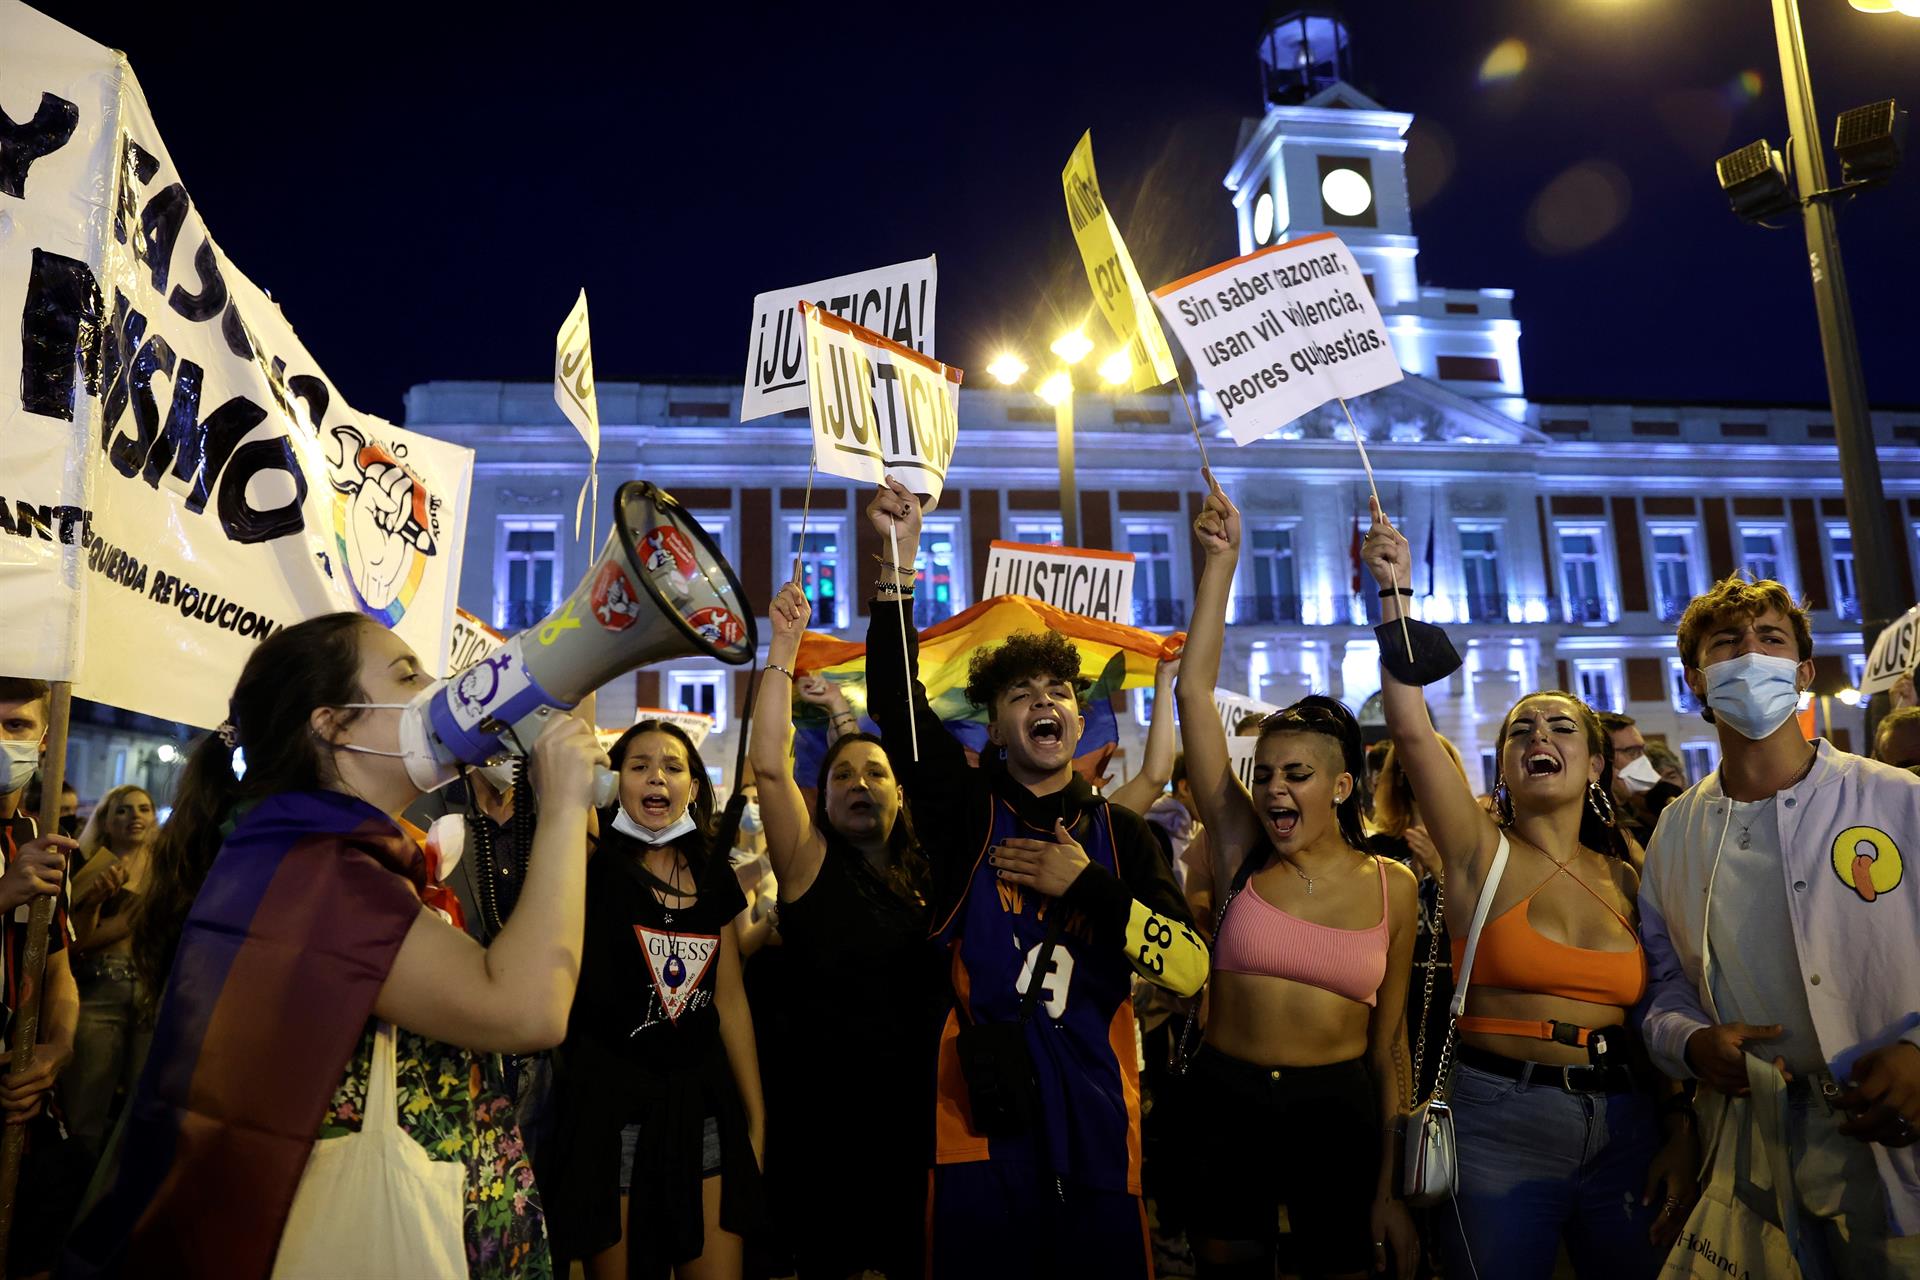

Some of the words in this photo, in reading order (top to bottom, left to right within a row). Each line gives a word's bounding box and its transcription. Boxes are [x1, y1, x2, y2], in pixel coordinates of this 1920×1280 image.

[1178, 295, 1217, 327] Sin
[1216, 271, 1274, 312] saber
[754, 279, 927, 387] ¡JUCIA!
[1202, 330, 1256, 367] usan
[1252, 309, 1285, 342] vil
[1215, 362, 1289, 418] peores
[1312, 328, 1386, 366] bestias.
[813, 335, 956, 472] ¡JUSTICIA
[649, 937, 709, 961] GUESS
[1677, 1230, 1738, 1278] Holland
